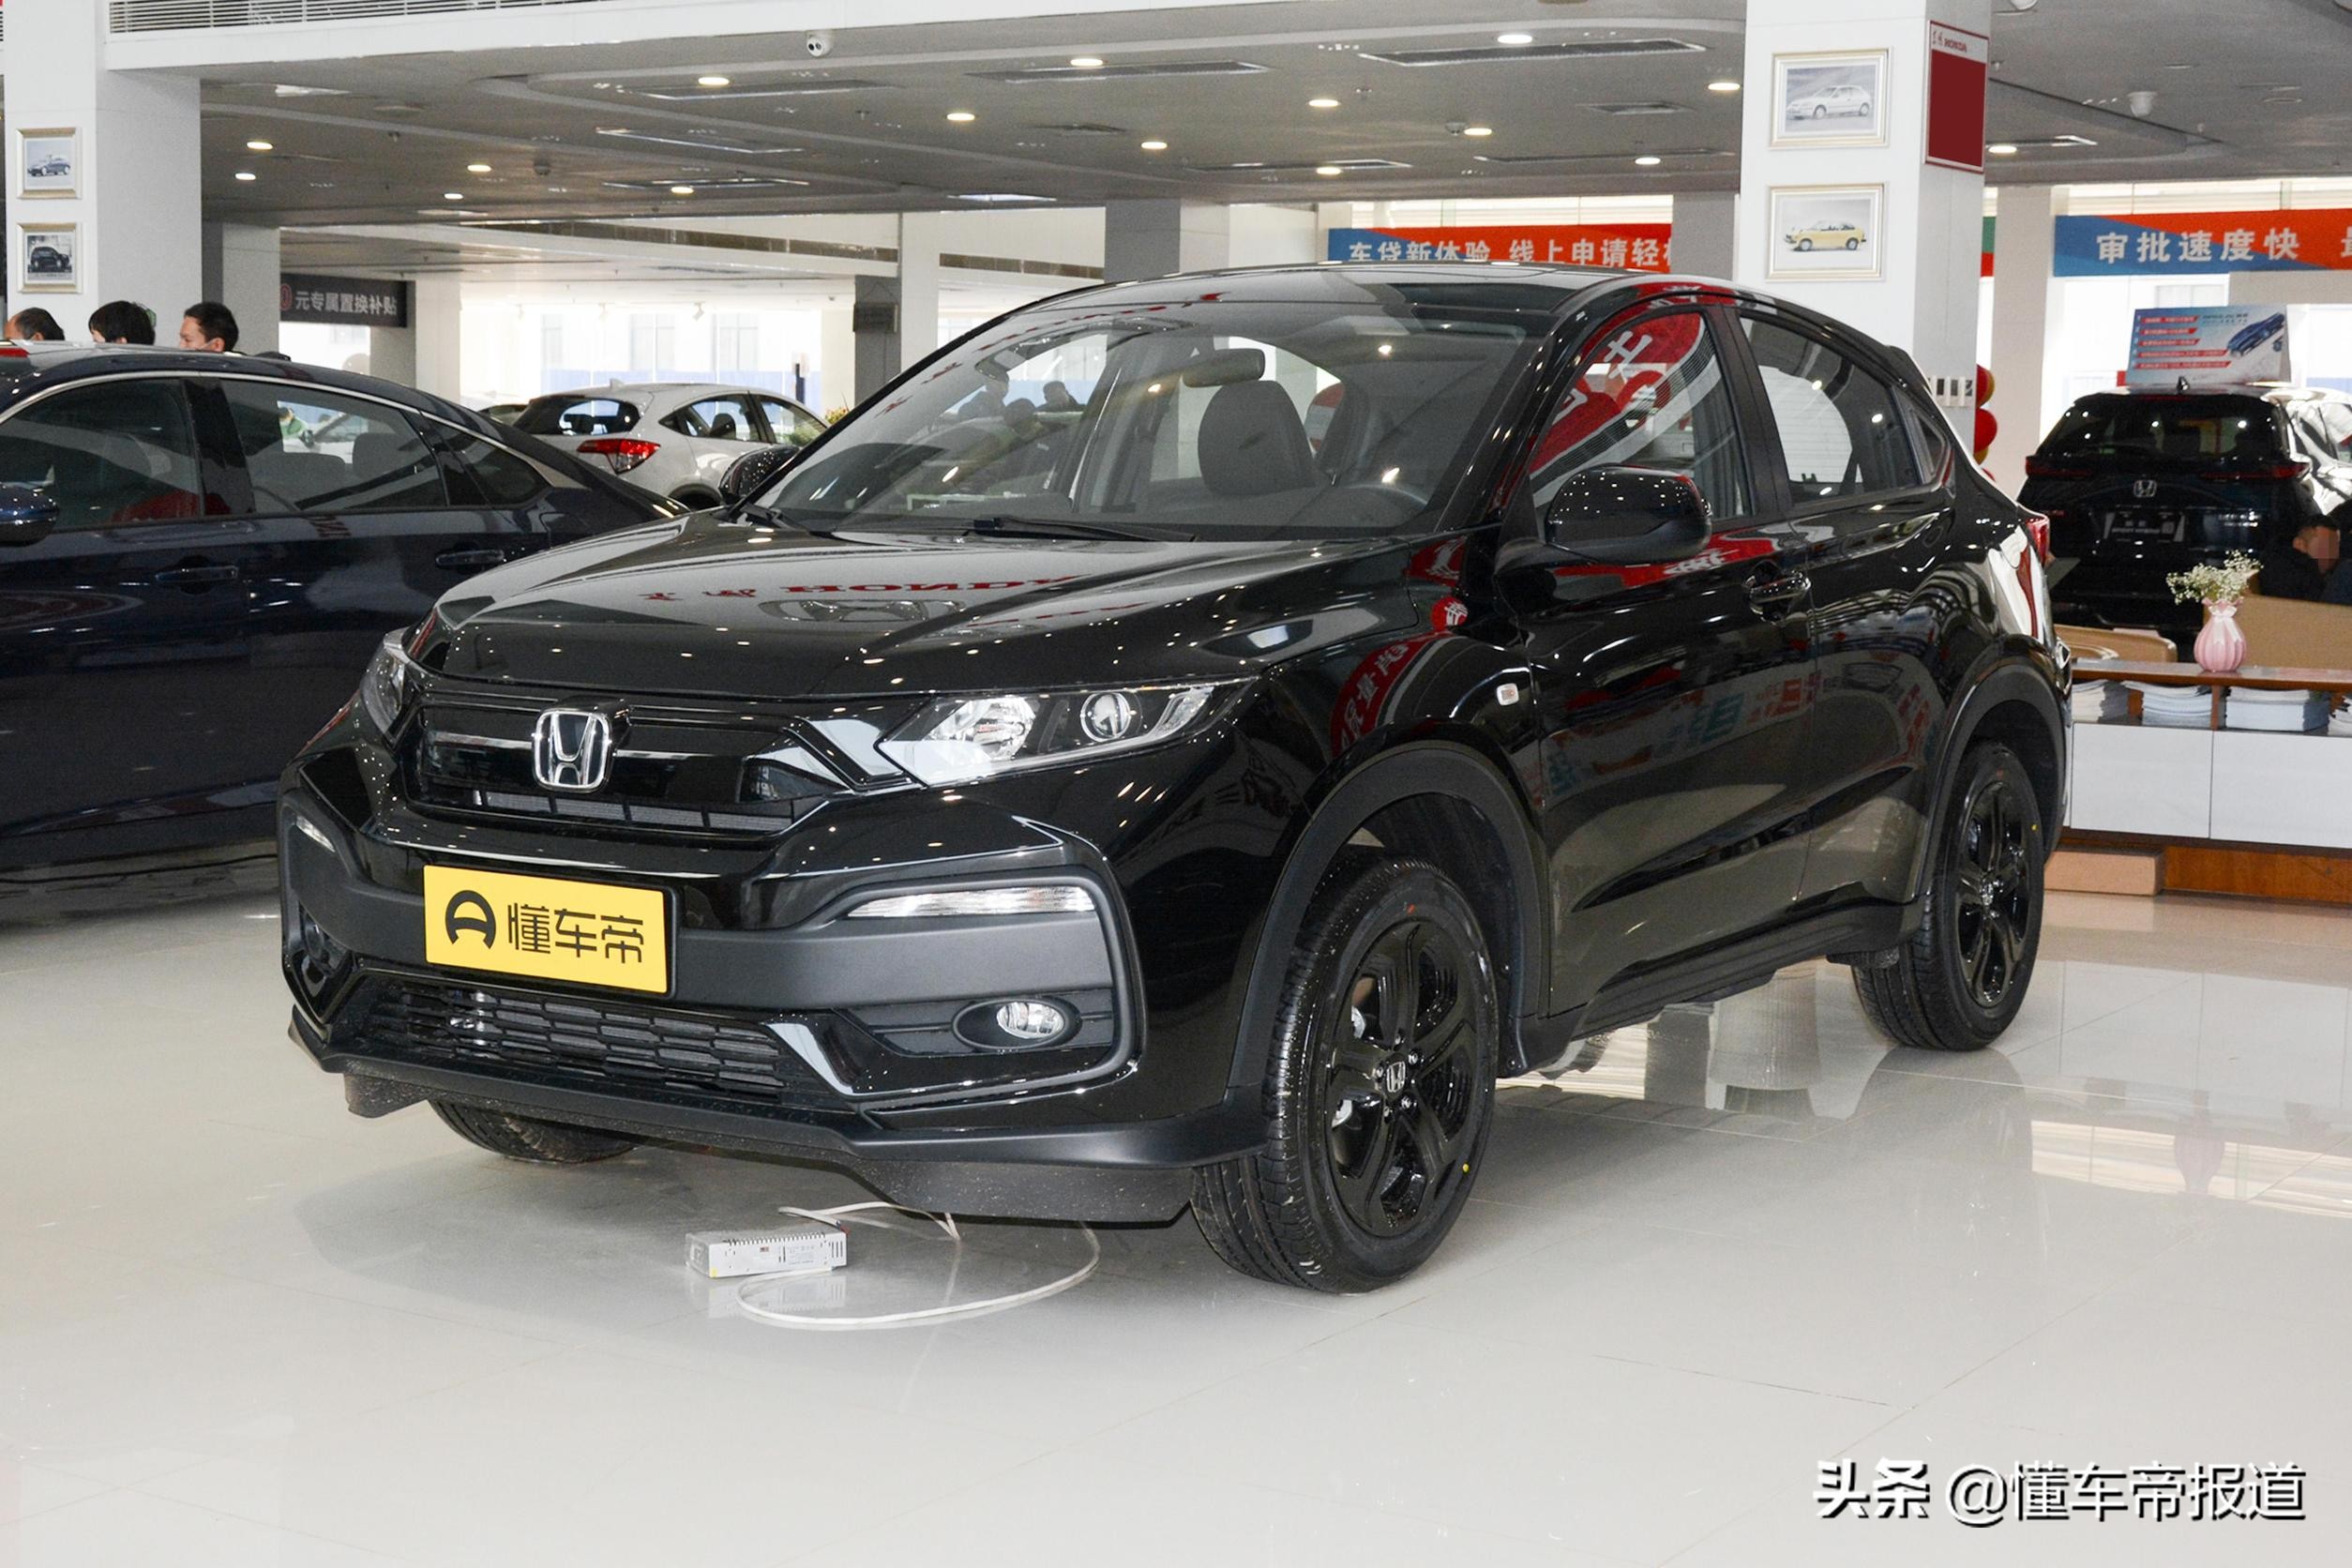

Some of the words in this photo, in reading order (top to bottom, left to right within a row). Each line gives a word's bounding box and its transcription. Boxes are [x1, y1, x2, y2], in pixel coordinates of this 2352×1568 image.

[2096, 228, 2299, 264] 审批速度快
[507, 902, 645, 964] 懂车帝
